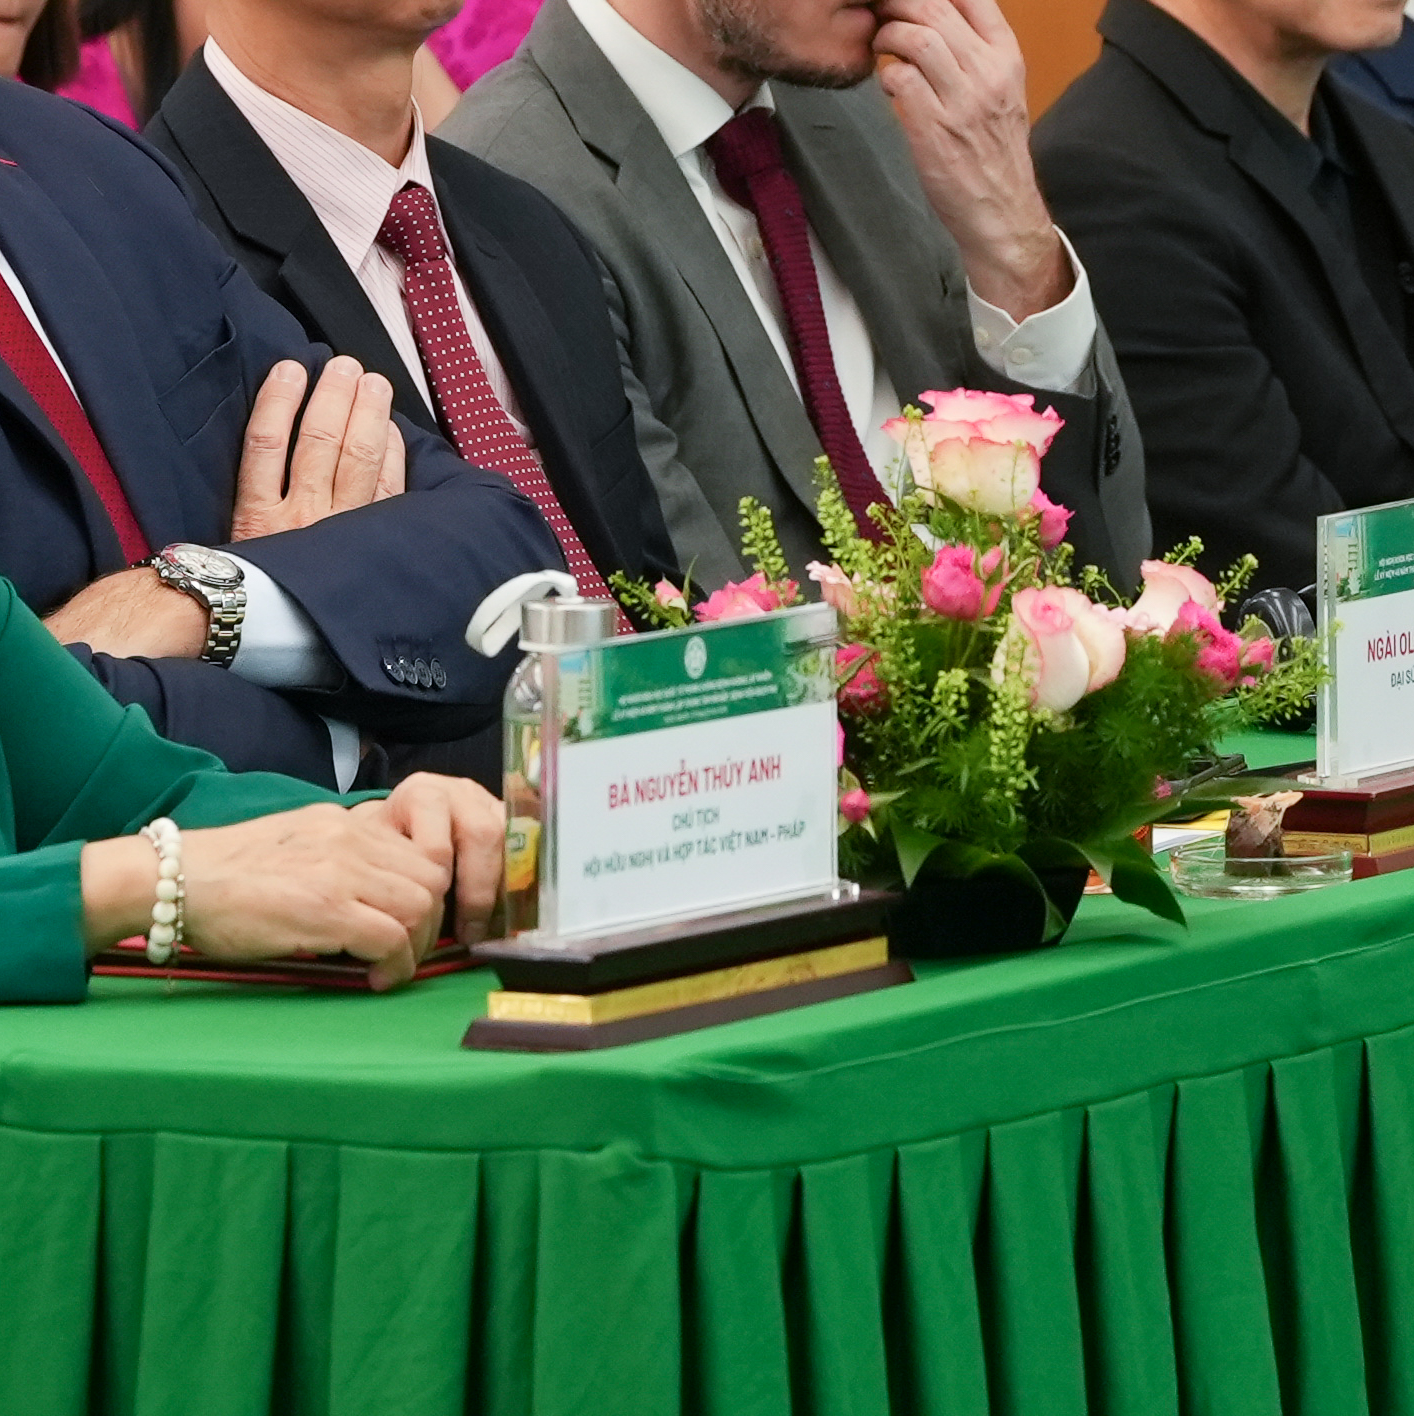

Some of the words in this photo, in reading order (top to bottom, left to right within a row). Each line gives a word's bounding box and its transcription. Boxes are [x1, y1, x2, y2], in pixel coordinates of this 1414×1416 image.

[1368, 630, 1397, 664] NGÀI
[1391, 671, 1405, 691] ĐẠI
[609, 776, 630, 810] BÀ
[635, 759, 698, 806] NGUYỄN
[749, 754, 781, 783] ANH
